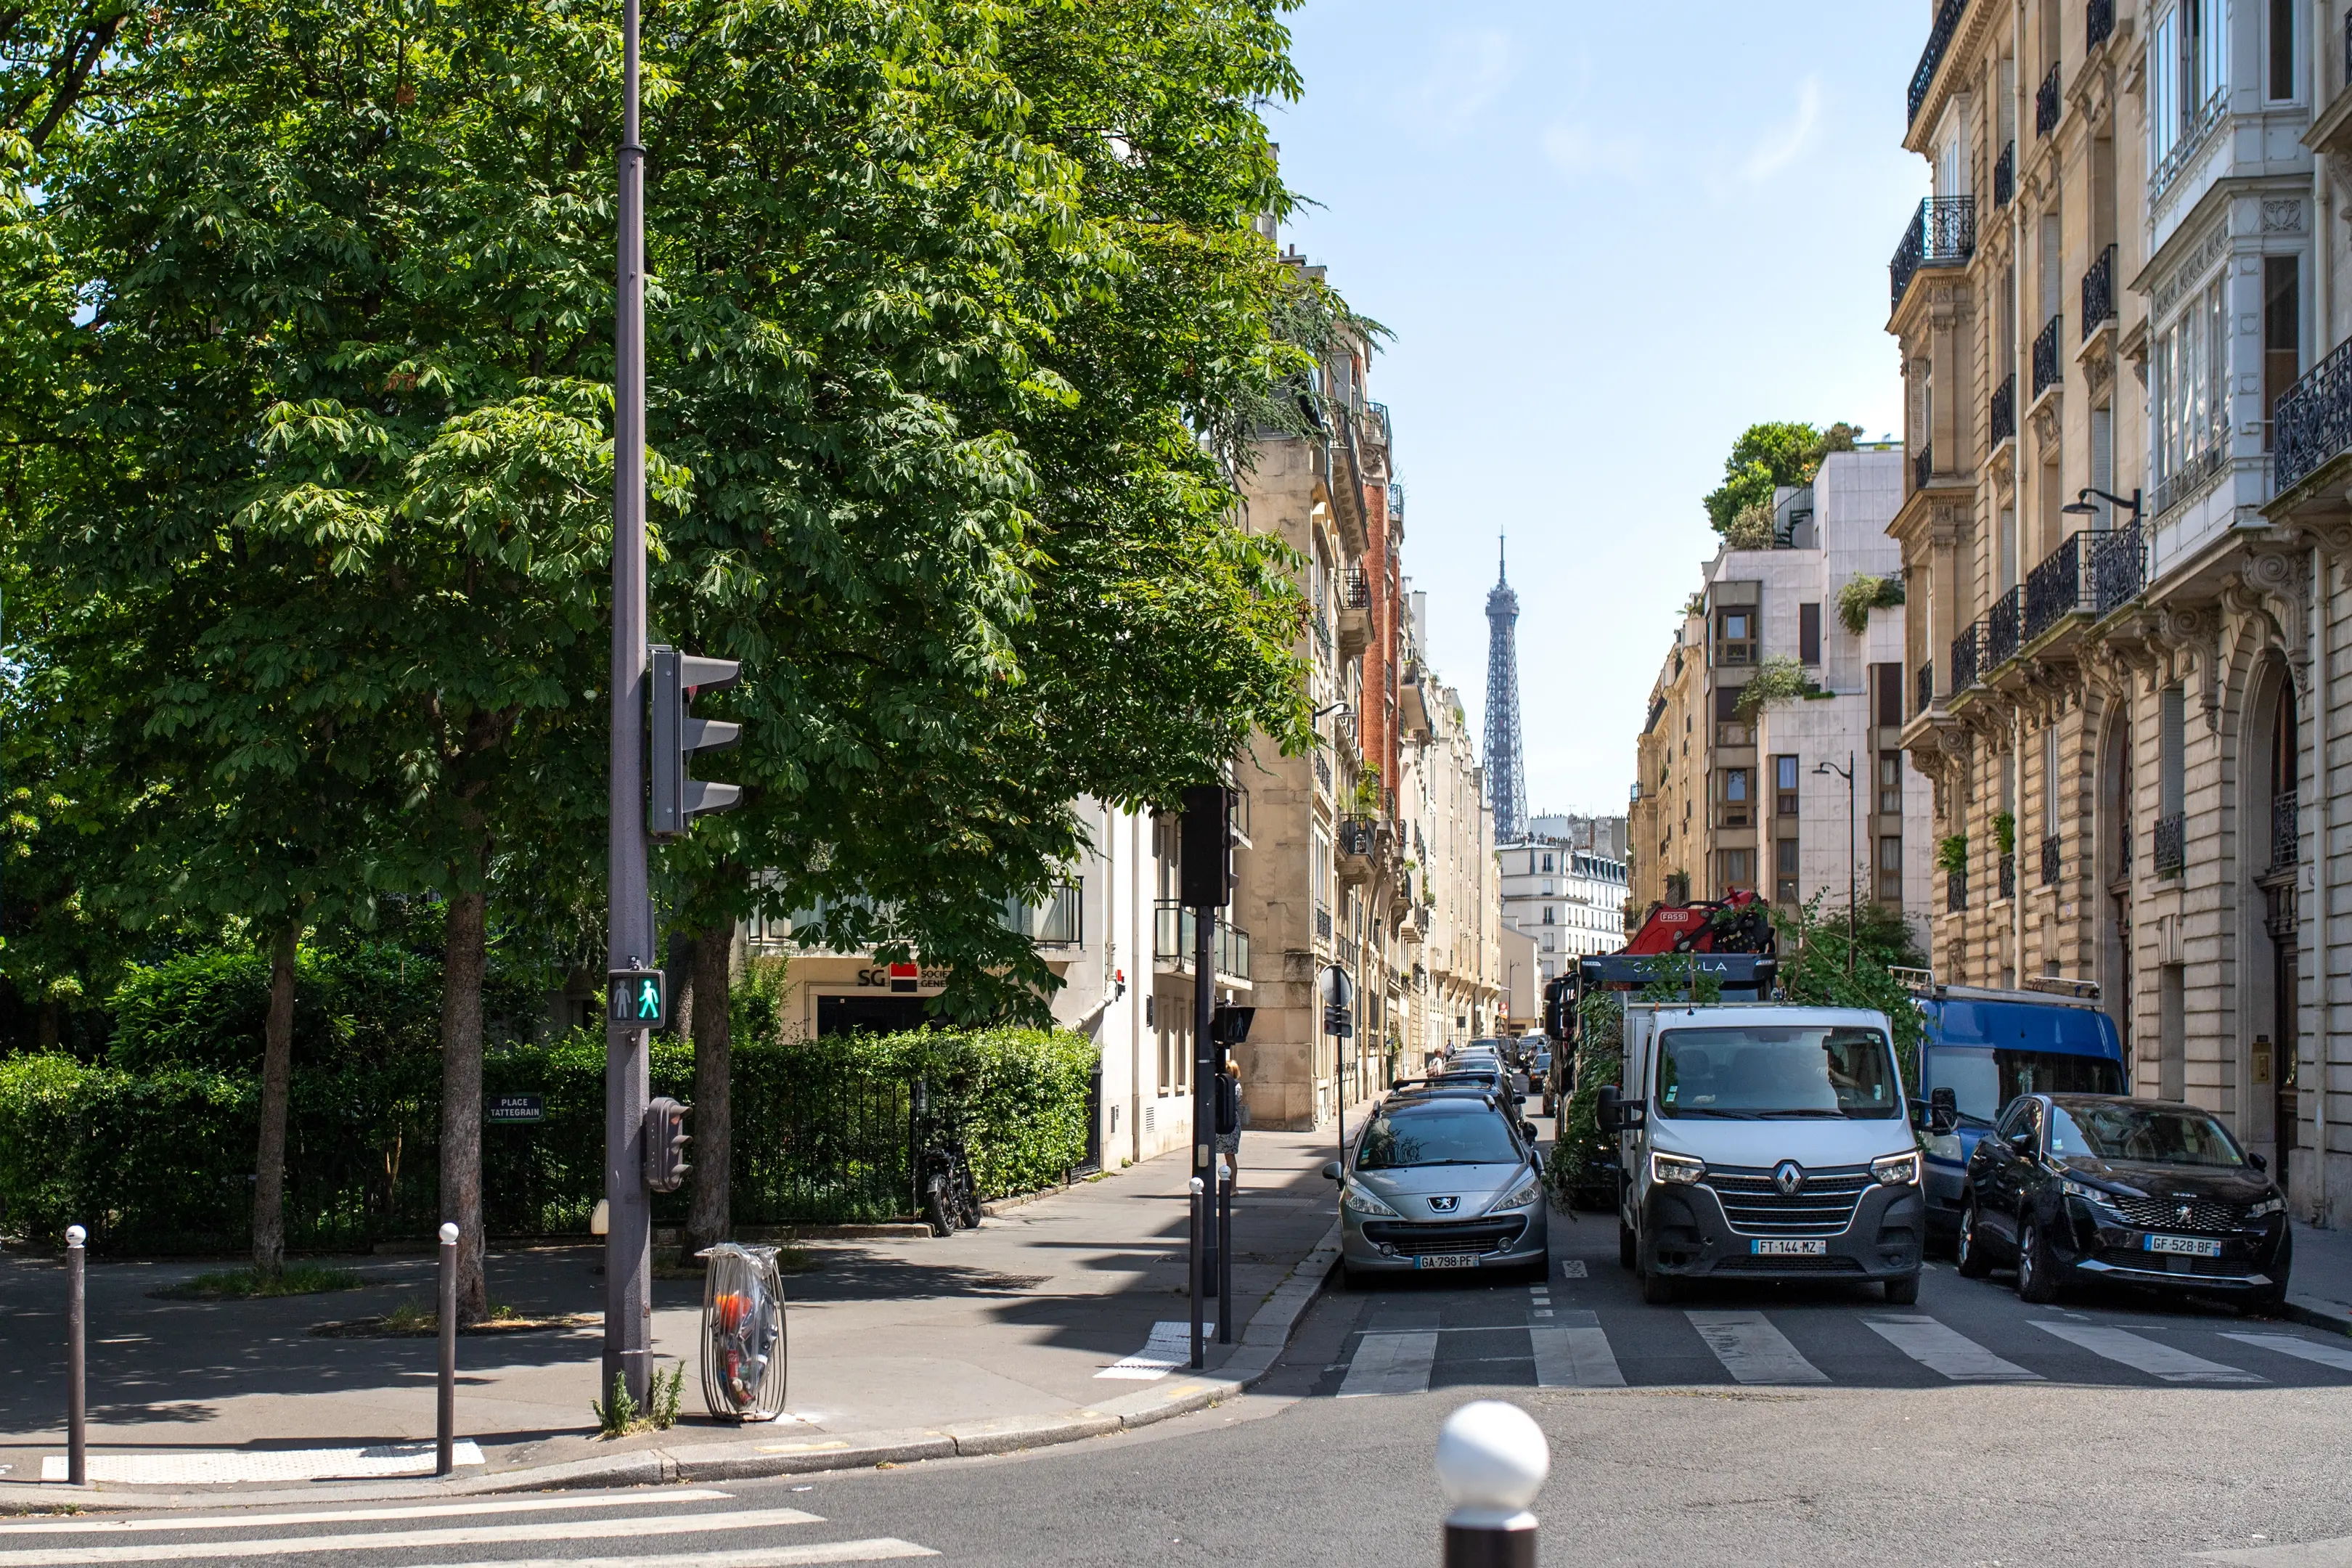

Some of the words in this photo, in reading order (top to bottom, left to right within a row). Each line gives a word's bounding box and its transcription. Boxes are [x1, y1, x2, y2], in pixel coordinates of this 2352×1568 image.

[857, 970, 886, 987] SG
[1760, 1241, 1816, 1253] FT-144-MZ
[2153, 1238, 2212, 1254] GF-528-BF
[1422, 1255, 1472, 1267] GA-798-PF
